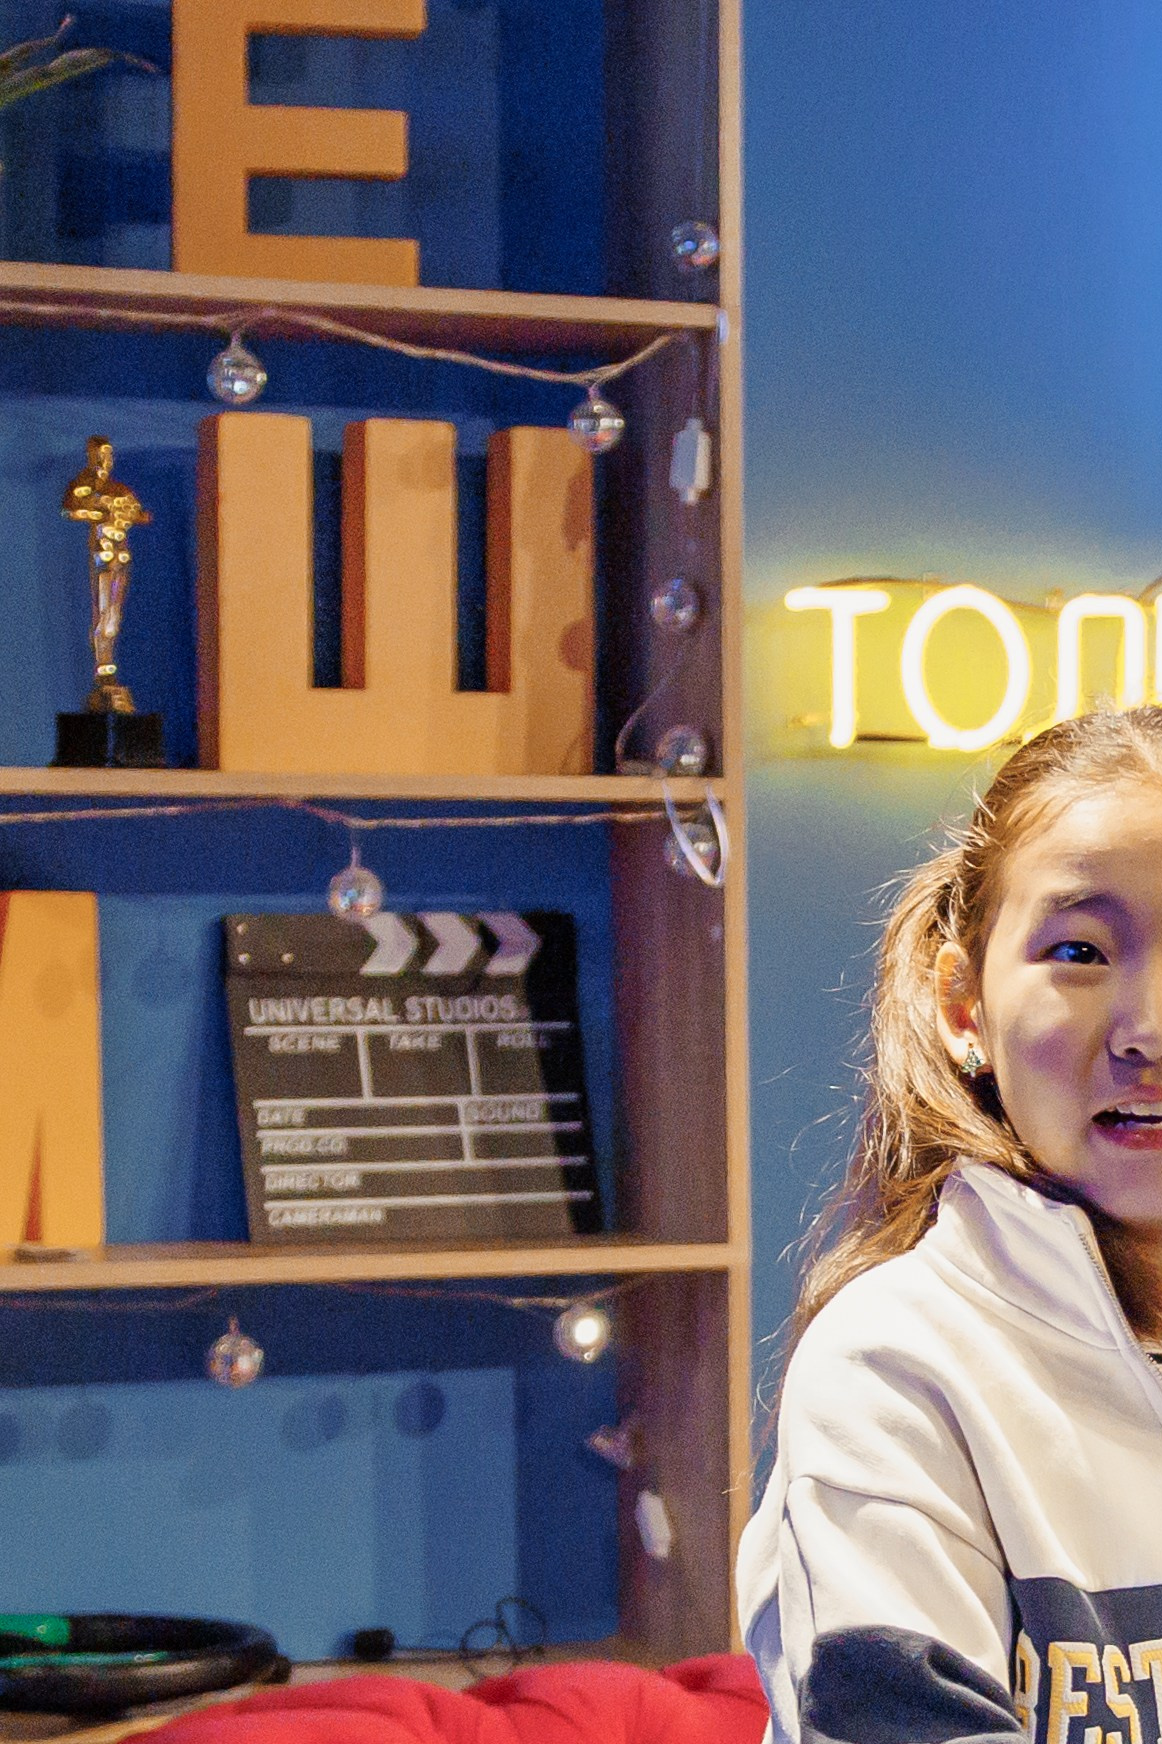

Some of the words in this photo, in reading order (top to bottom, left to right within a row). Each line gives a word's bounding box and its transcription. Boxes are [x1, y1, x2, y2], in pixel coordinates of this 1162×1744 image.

[248, 996, 399, 1025] UNIVERSAL
[405, 995, 516, 1023] STUDIOS
[268, 1034, 341, 1053] SCENE
[389, 1033, 442, 1050] TAKE
[256, 1107, 306, 1126] DATE
[468, 1103, 542, 1123] SOUND
[265, 1172, 361, 1192] DIRECTOR
[268, 1207, 384, 1228] CAMERAMAN
